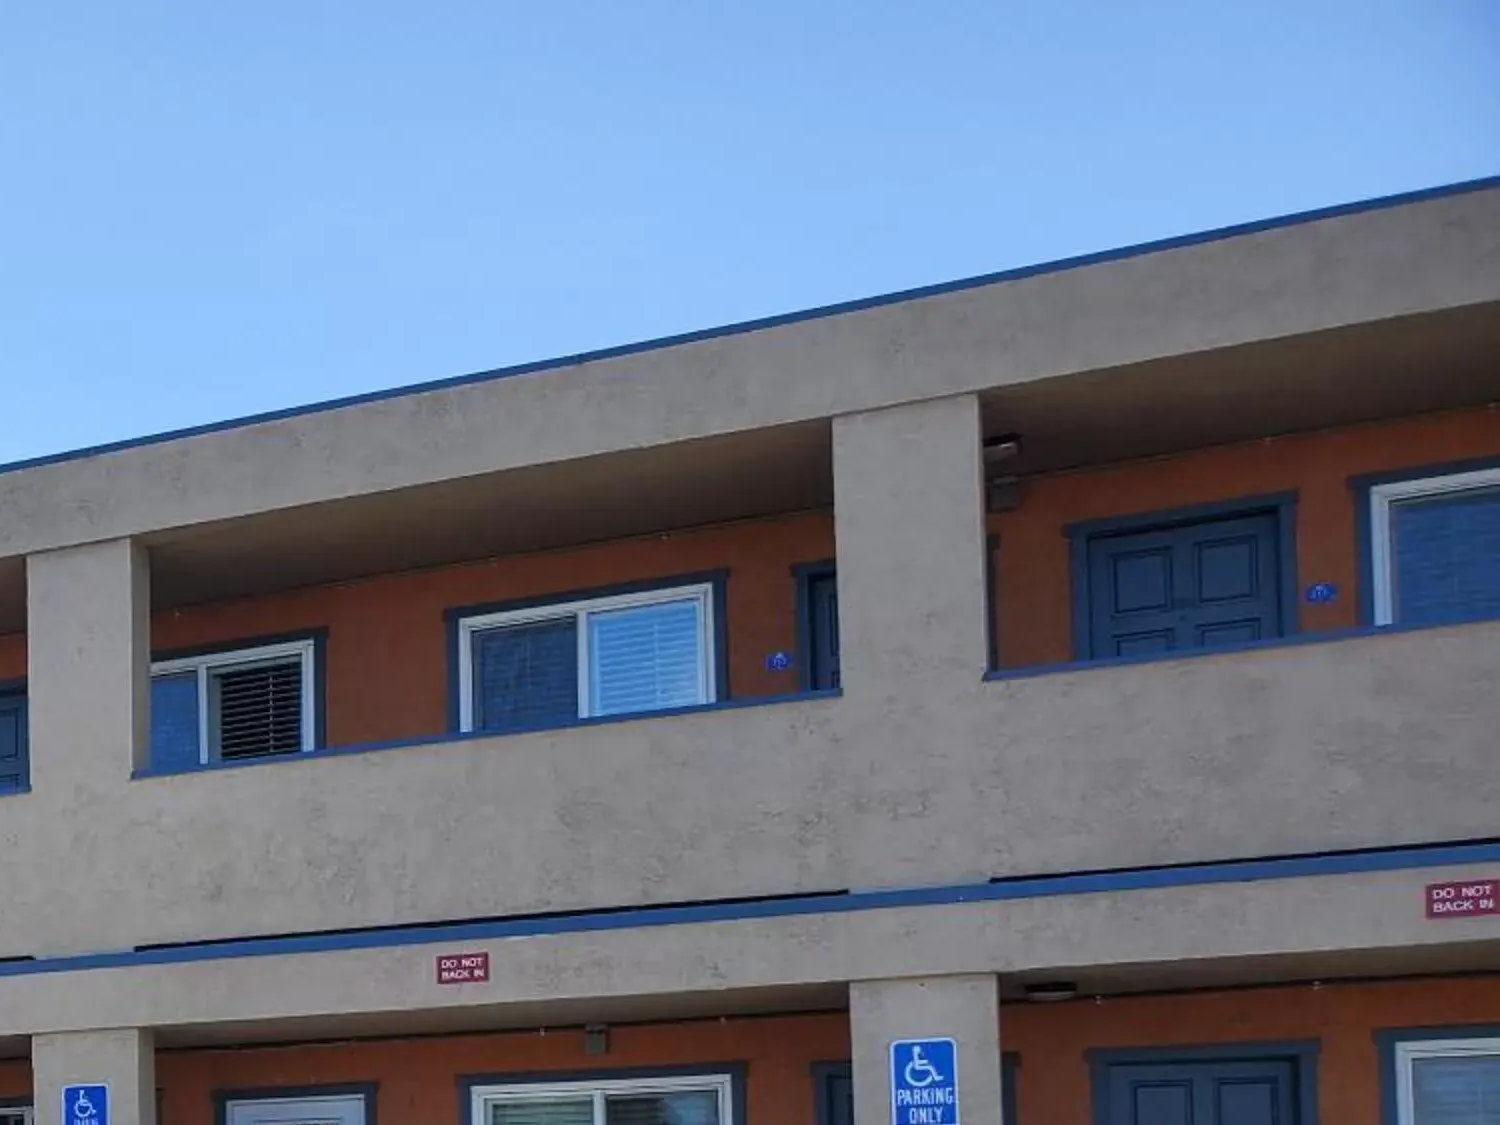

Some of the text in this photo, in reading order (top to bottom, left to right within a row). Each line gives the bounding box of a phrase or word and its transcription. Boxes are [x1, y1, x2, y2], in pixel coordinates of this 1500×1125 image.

[1433, 885, 1492, 899] DO NOT
[1433, 898, 1494, 913] BACK IN
[441, 957, 483, 969] DO NOT
[441, 968, 485, 980] BACK IN
[897, 1087, 954, 1106] PARKING
[908, 1107, 943, 1124] ONLY
